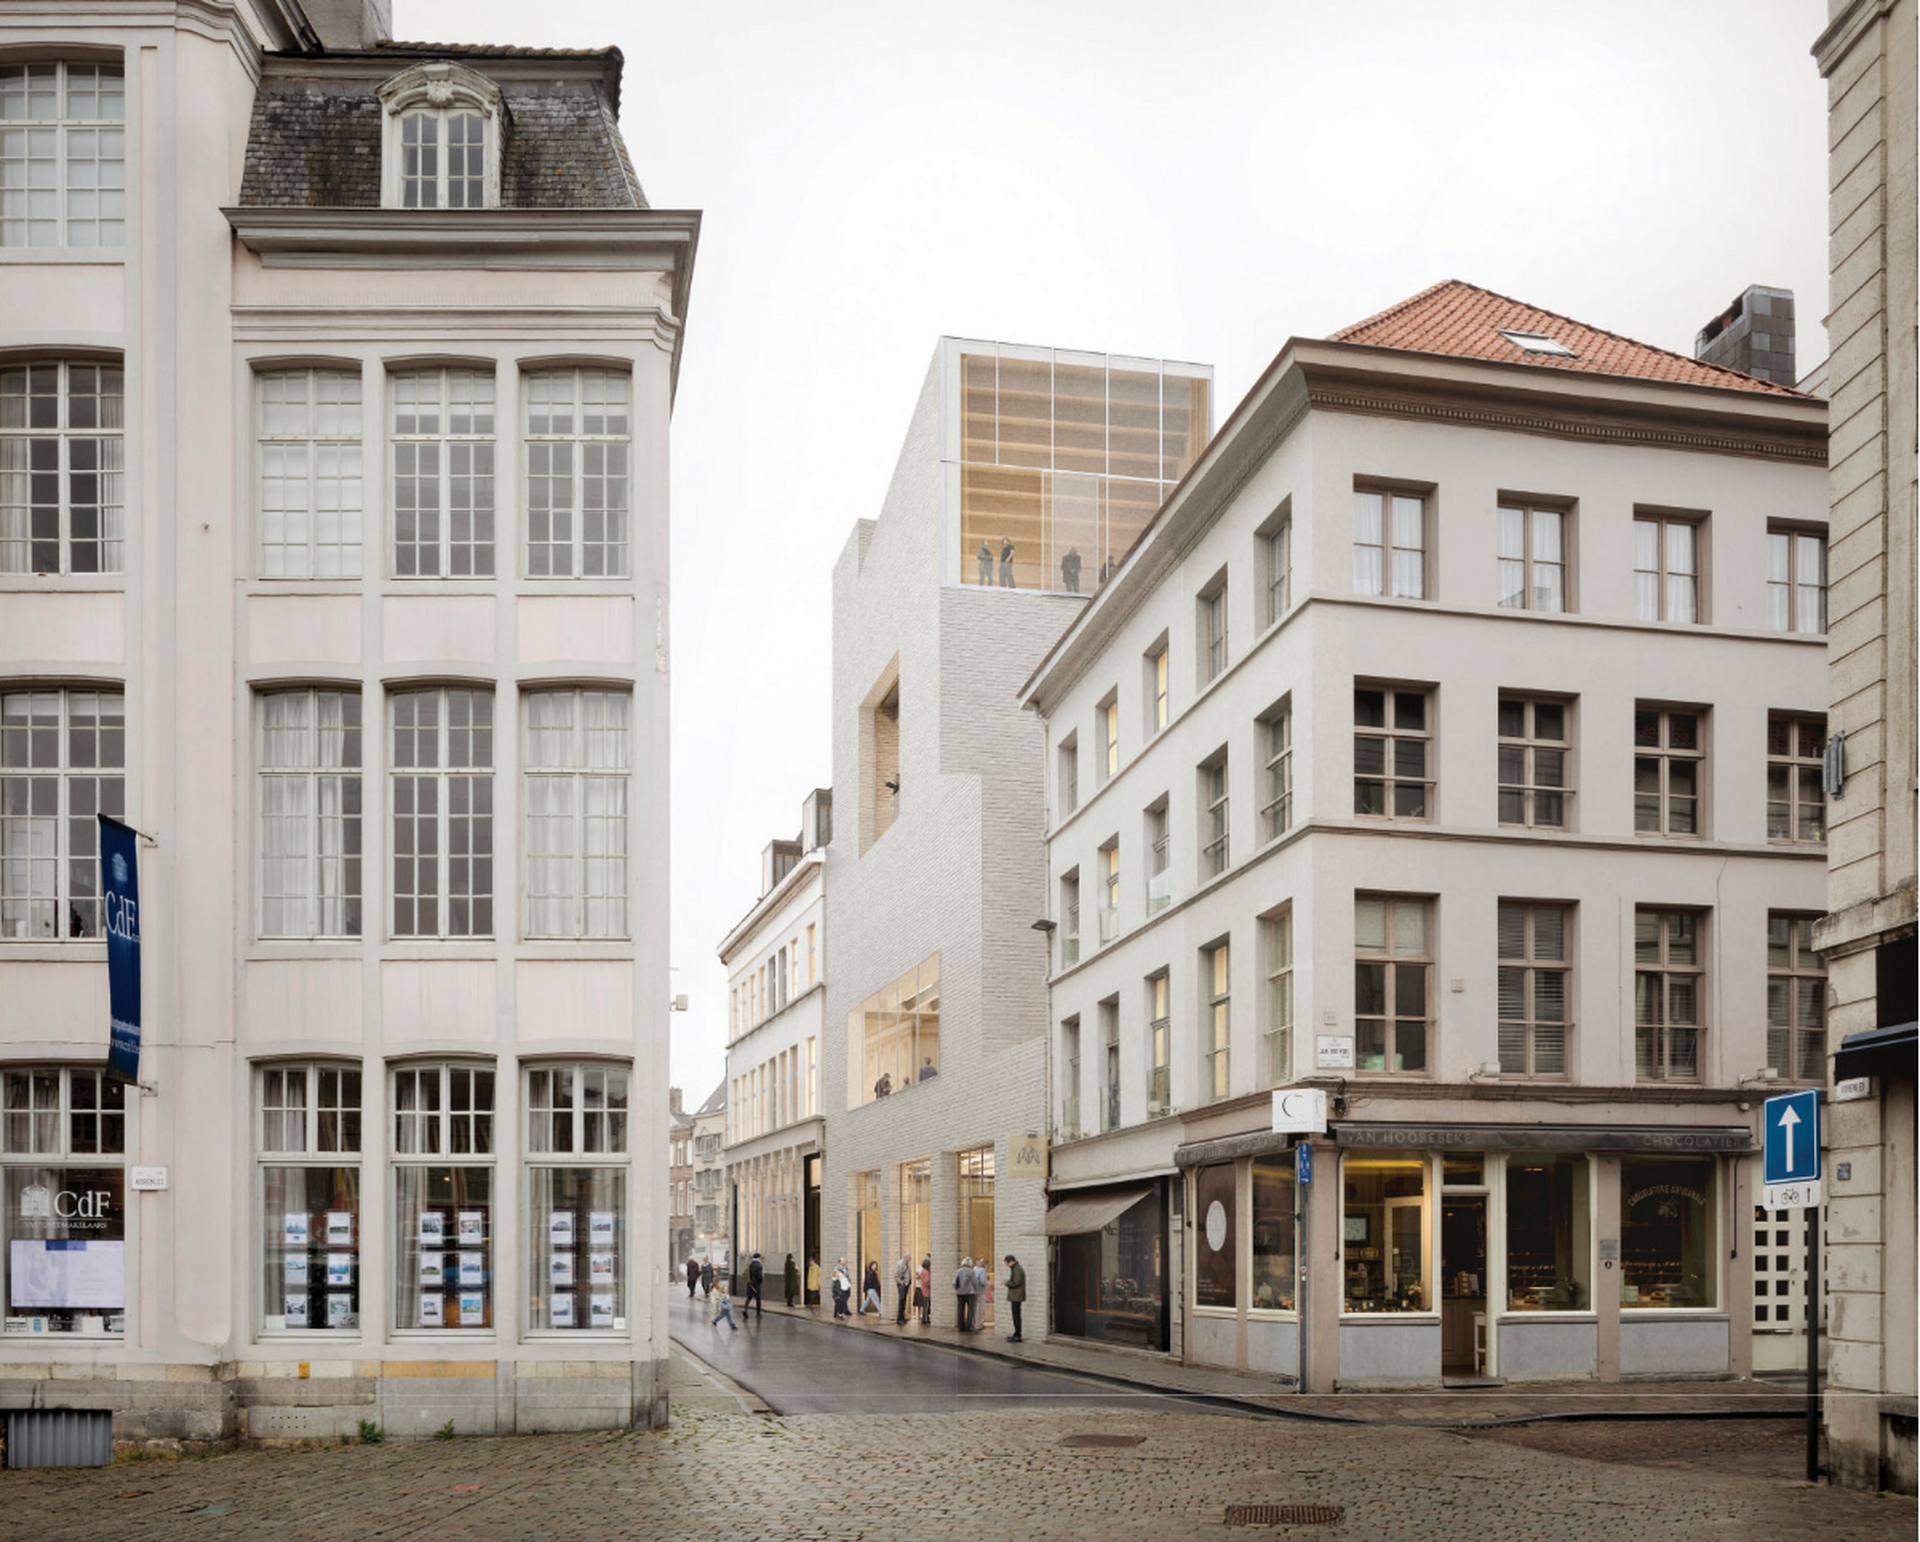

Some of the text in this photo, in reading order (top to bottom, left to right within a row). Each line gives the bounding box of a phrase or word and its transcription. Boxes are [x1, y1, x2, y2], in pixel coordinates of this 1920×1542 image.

[105, 891, 136, 940] CdF
[1348, 1131, 1472, 1144] VAN HOOREBEKE
[54, 1190, 112, 1218] CdF
